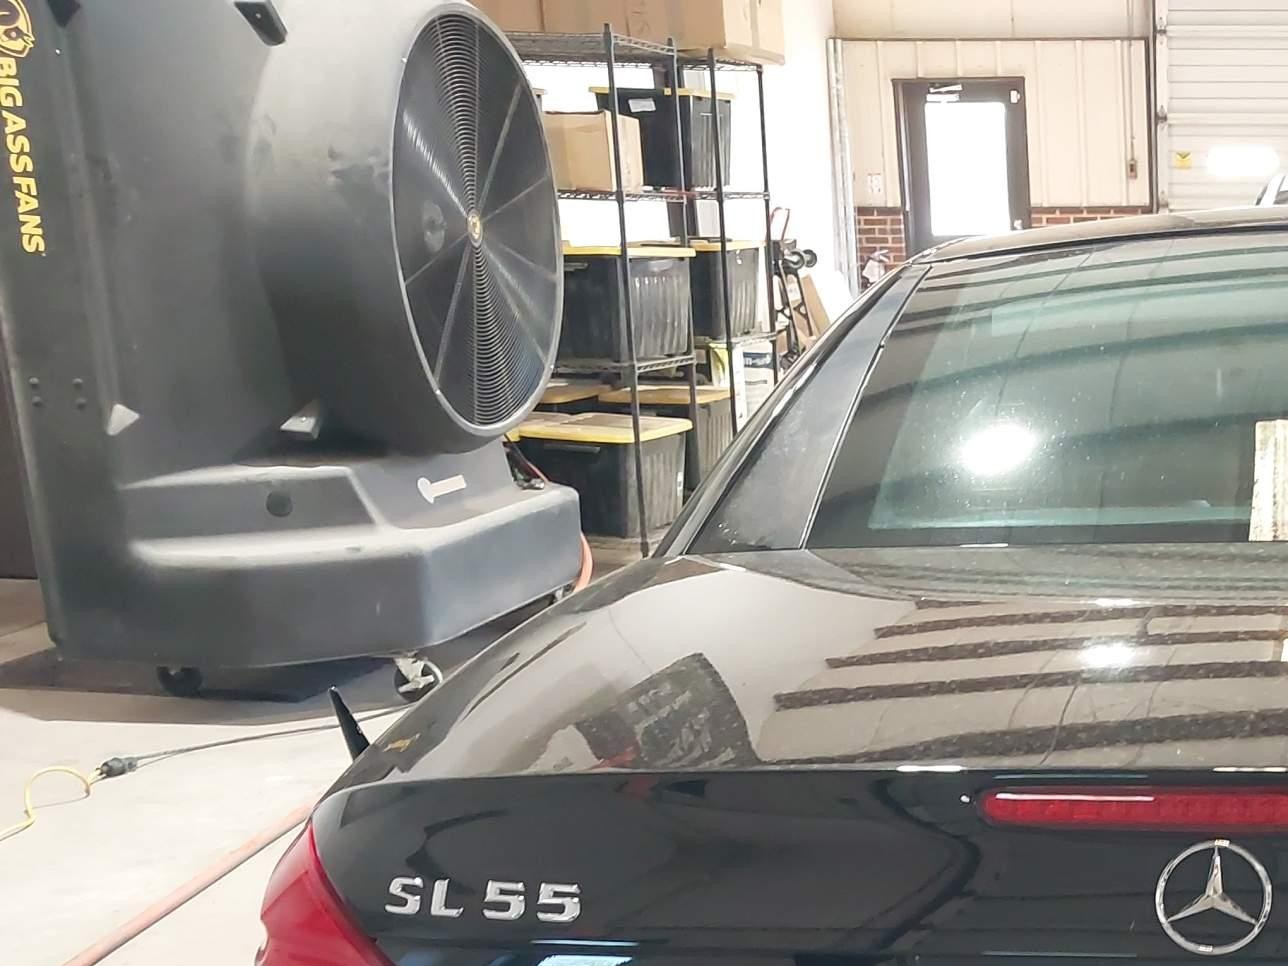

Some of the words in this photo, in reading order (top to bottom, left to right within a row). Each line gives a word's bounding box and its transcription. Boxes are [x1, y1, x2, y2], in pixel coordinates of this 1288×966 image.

[0, 56, 23, 107] BIG
[2, 109, 33, 174] ASS
[12, 175, 46, 254] FANS
[384, 876, 464, 918] SL
[482, 879, 581, 922] 55
